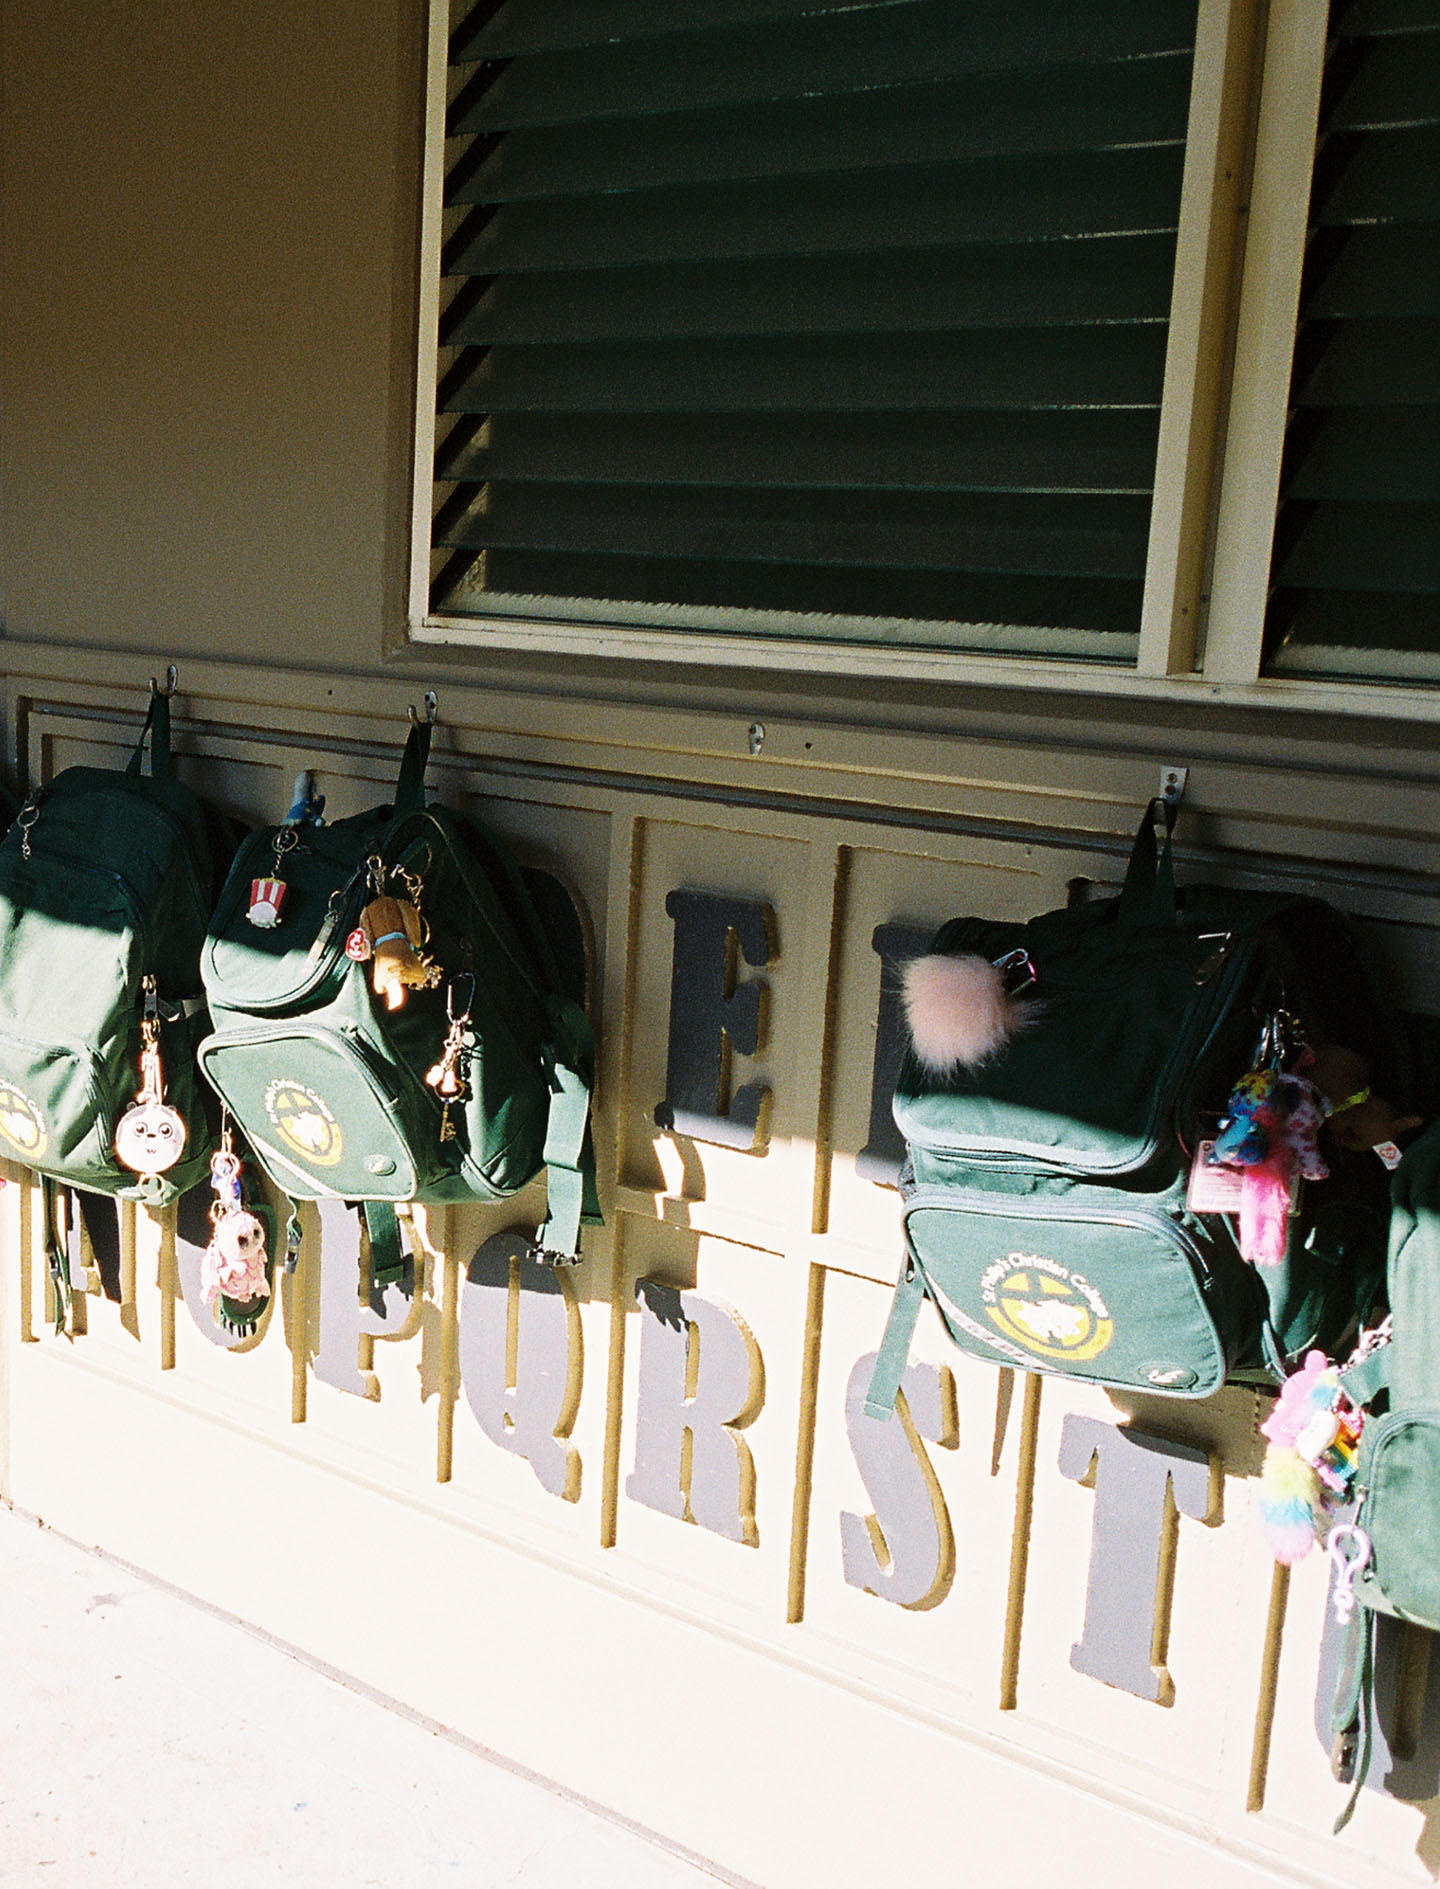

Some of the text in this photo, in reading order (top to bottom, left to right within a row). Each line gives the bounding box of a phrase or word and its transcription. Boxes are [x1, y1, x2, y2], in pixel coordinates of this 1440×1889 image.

[653, 890, 780, 1158] E
[1008, 1252, 1069, 1279] Christian
[459, 1232, 583, 1504] Q
[626, 1277, 766, 1548] R
[839, 1351, 960, 1611] S
[1058, 1412, 1226, 1708] T
